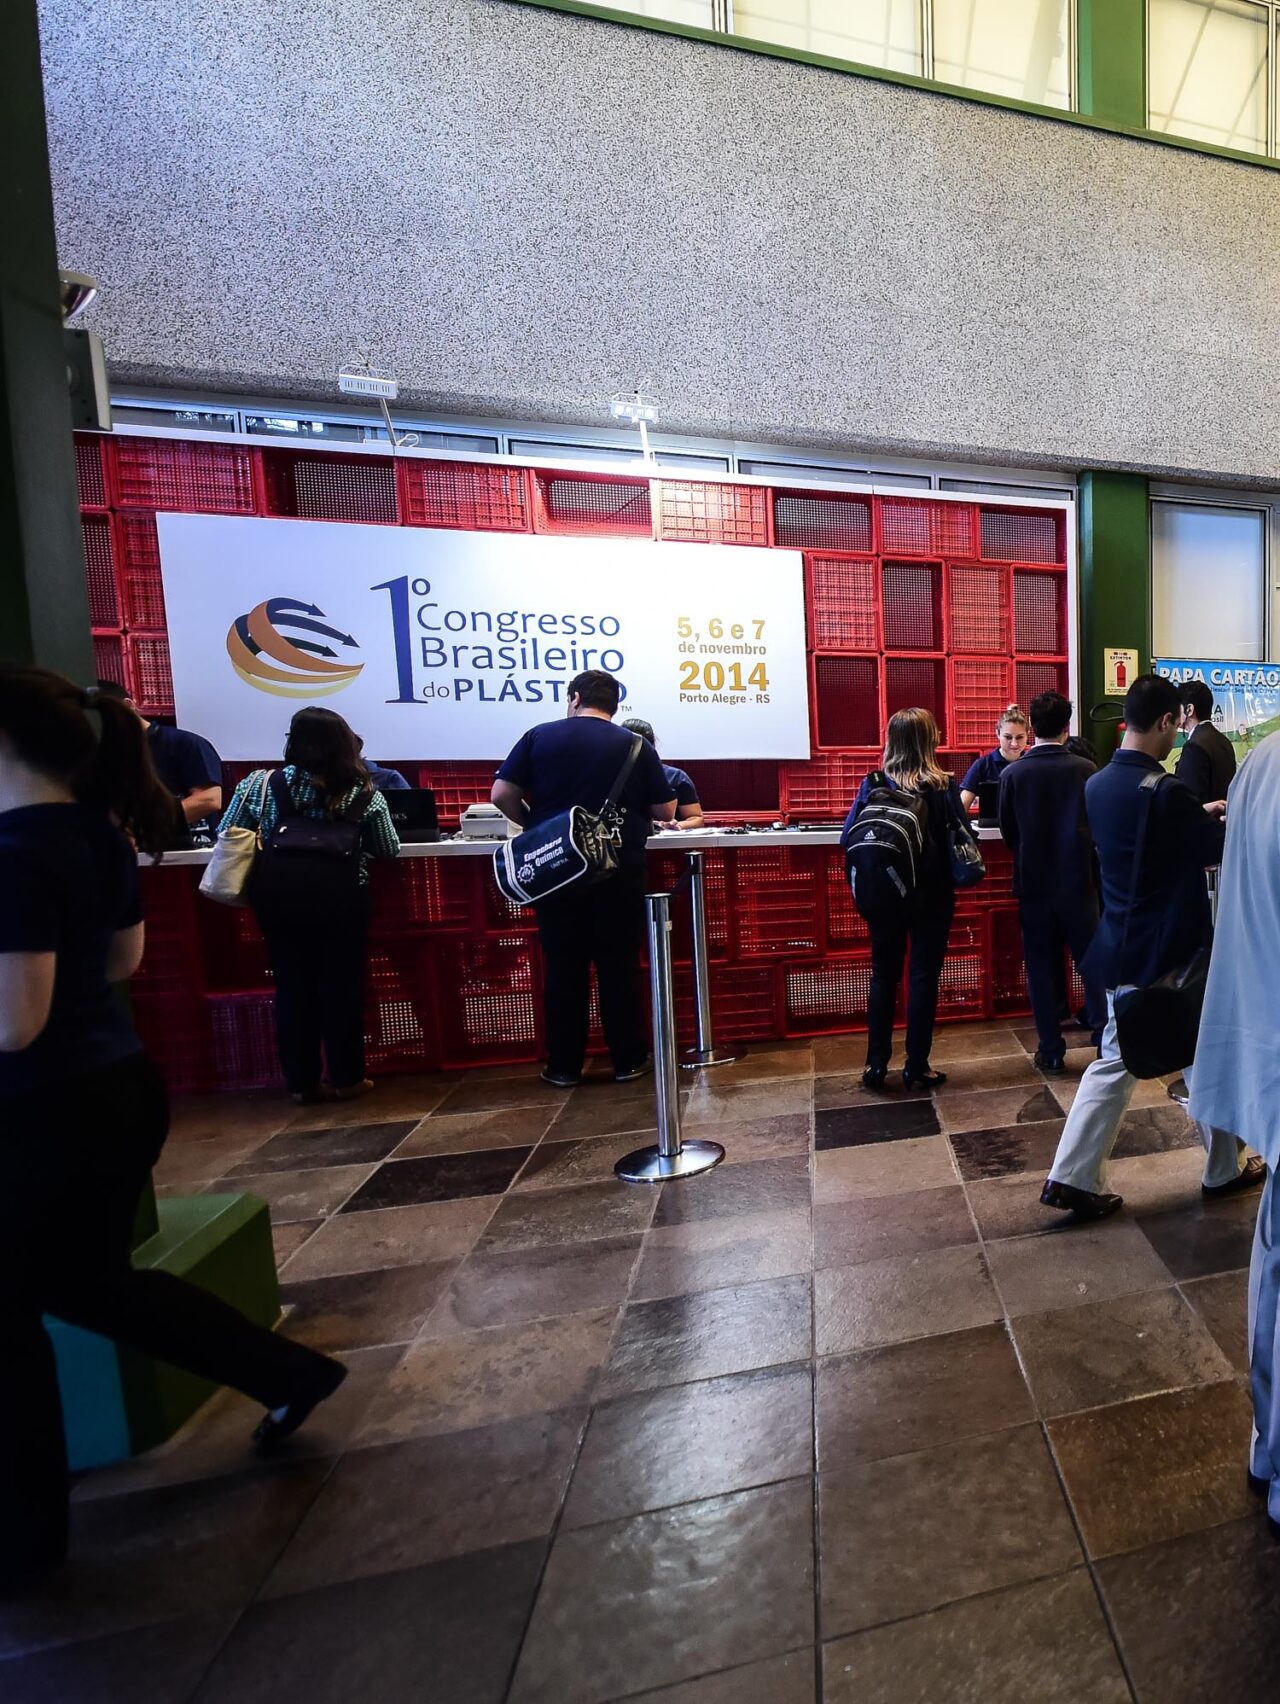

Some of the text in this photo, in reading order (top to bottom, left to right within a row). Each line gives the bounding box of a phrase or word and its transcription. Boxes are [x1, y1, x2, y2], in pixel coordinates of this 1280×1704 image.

[416, 602, 621, 643] Congresso
[677, 616, 766, 642] 5, 6 e 7
[420, 636, 625, 672] Brasileiro
[678, 641, 767, 655] de novembro
[422, 672, 628, 703] do PLÁST
[679, 660, 770, 691] 2014
[1160, 666, 1280, 687] PAPA CARTÃO
[679, 692, 709, 703] Porto
[711, 693, 747, 705] Alegre
[755, 694, 770, 704] RS
